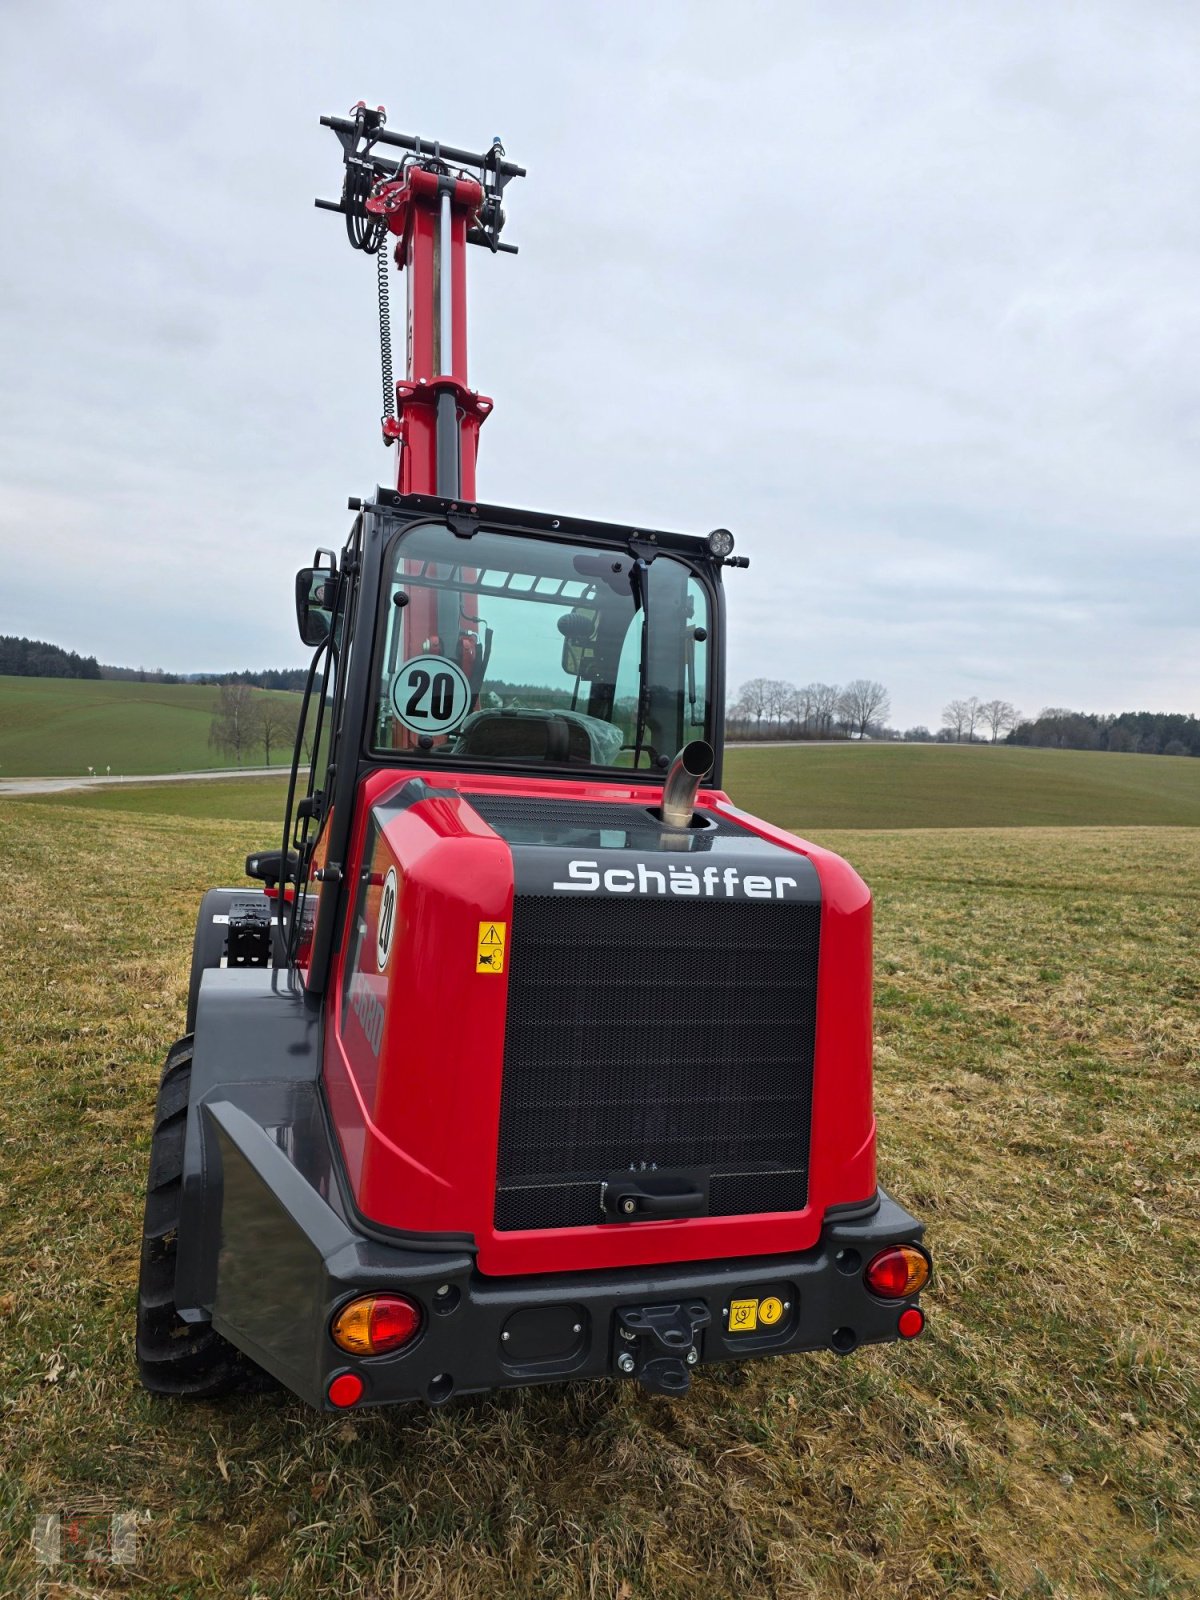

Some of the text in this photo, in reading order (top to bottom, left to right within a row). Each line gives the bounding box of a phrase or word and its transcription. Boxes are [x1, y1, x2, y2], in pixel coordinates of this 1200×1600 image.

[406, 670, 454, 720] 20
[553, 861, 797, 898] Schäffer
[379, 885, 394, 954] 20
